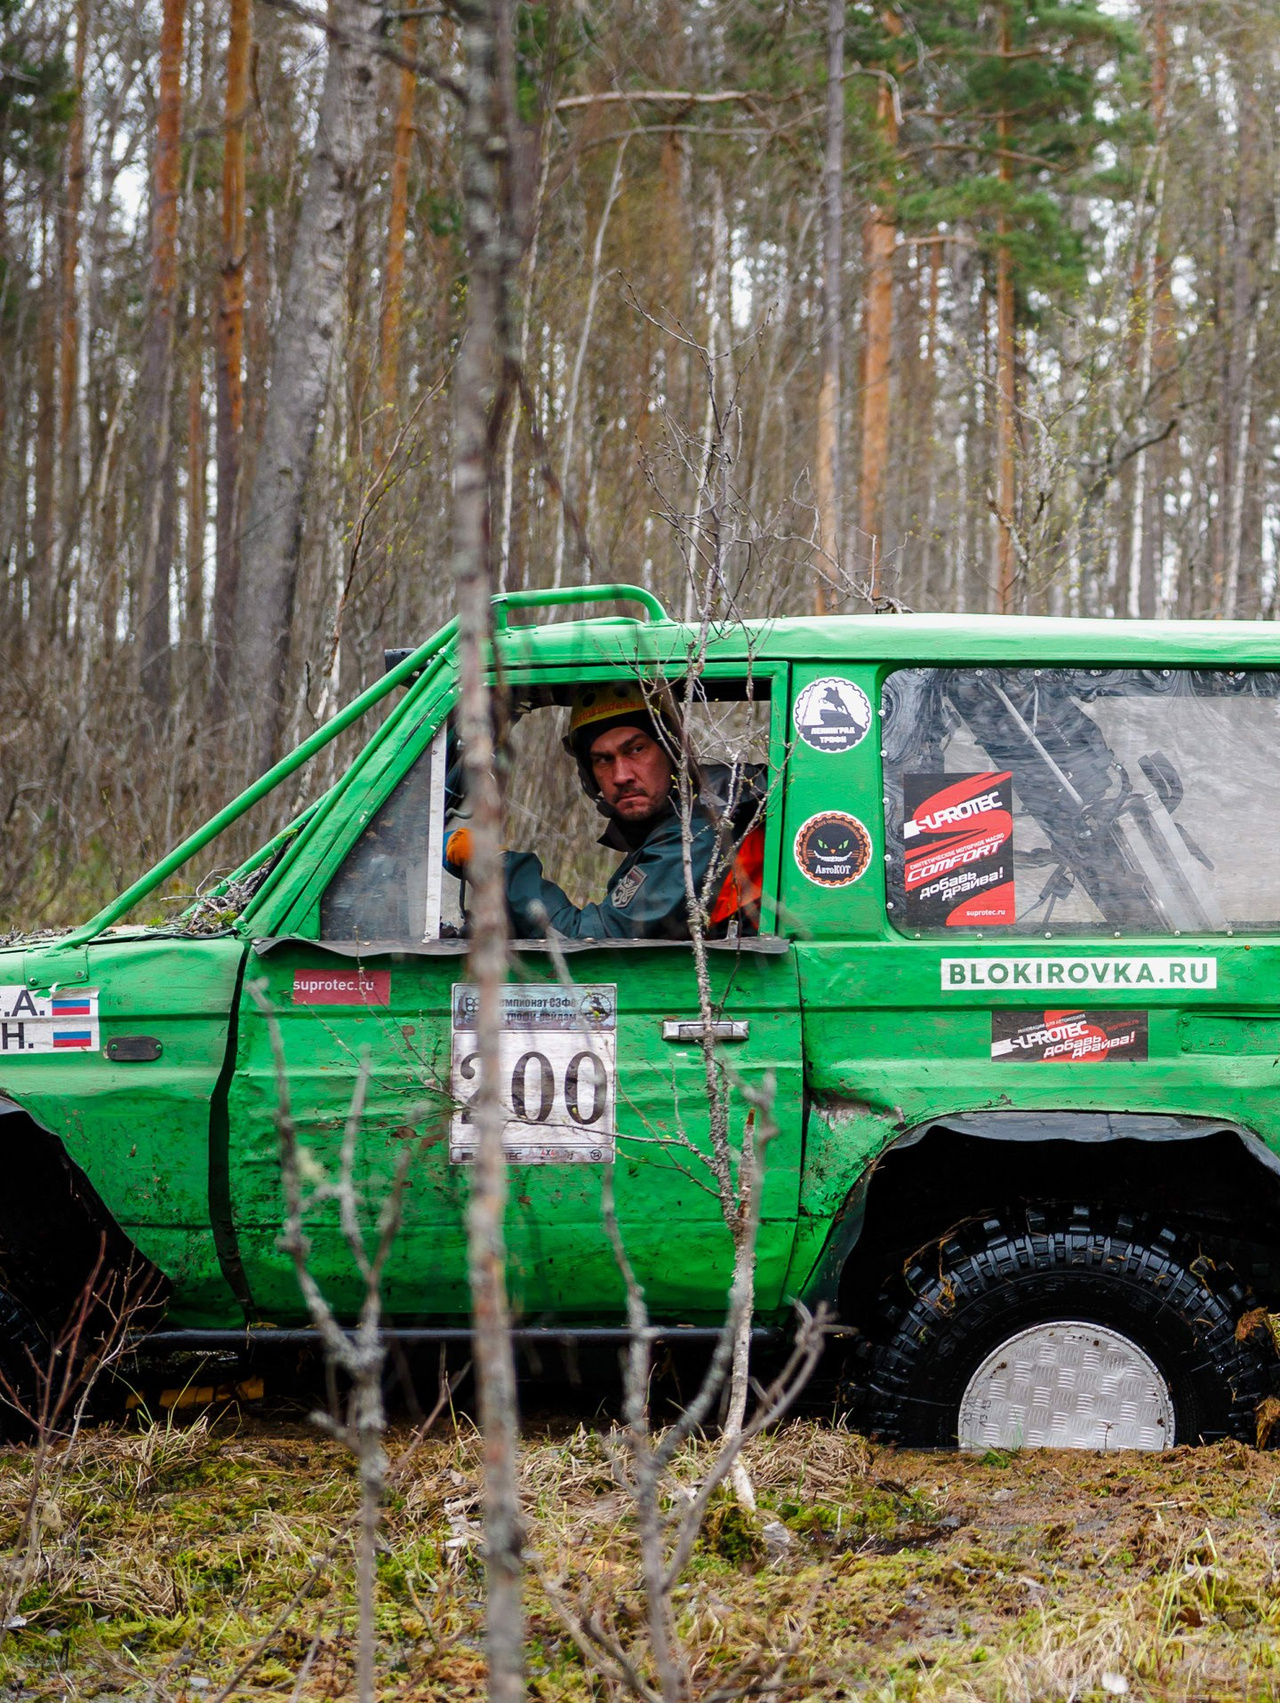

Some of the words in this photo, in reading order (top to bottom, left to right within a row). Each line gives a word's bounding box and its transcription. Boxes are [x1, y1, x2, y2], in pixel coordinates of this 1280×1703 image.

[907, 840, 1003, 882] COMFORT
[966, 909, 1006, 918] suprotec.ru
[949, 962, 1208, 985] BLOKIROVKA.RU
[293, 979, 374, 993] suprotec.ru
